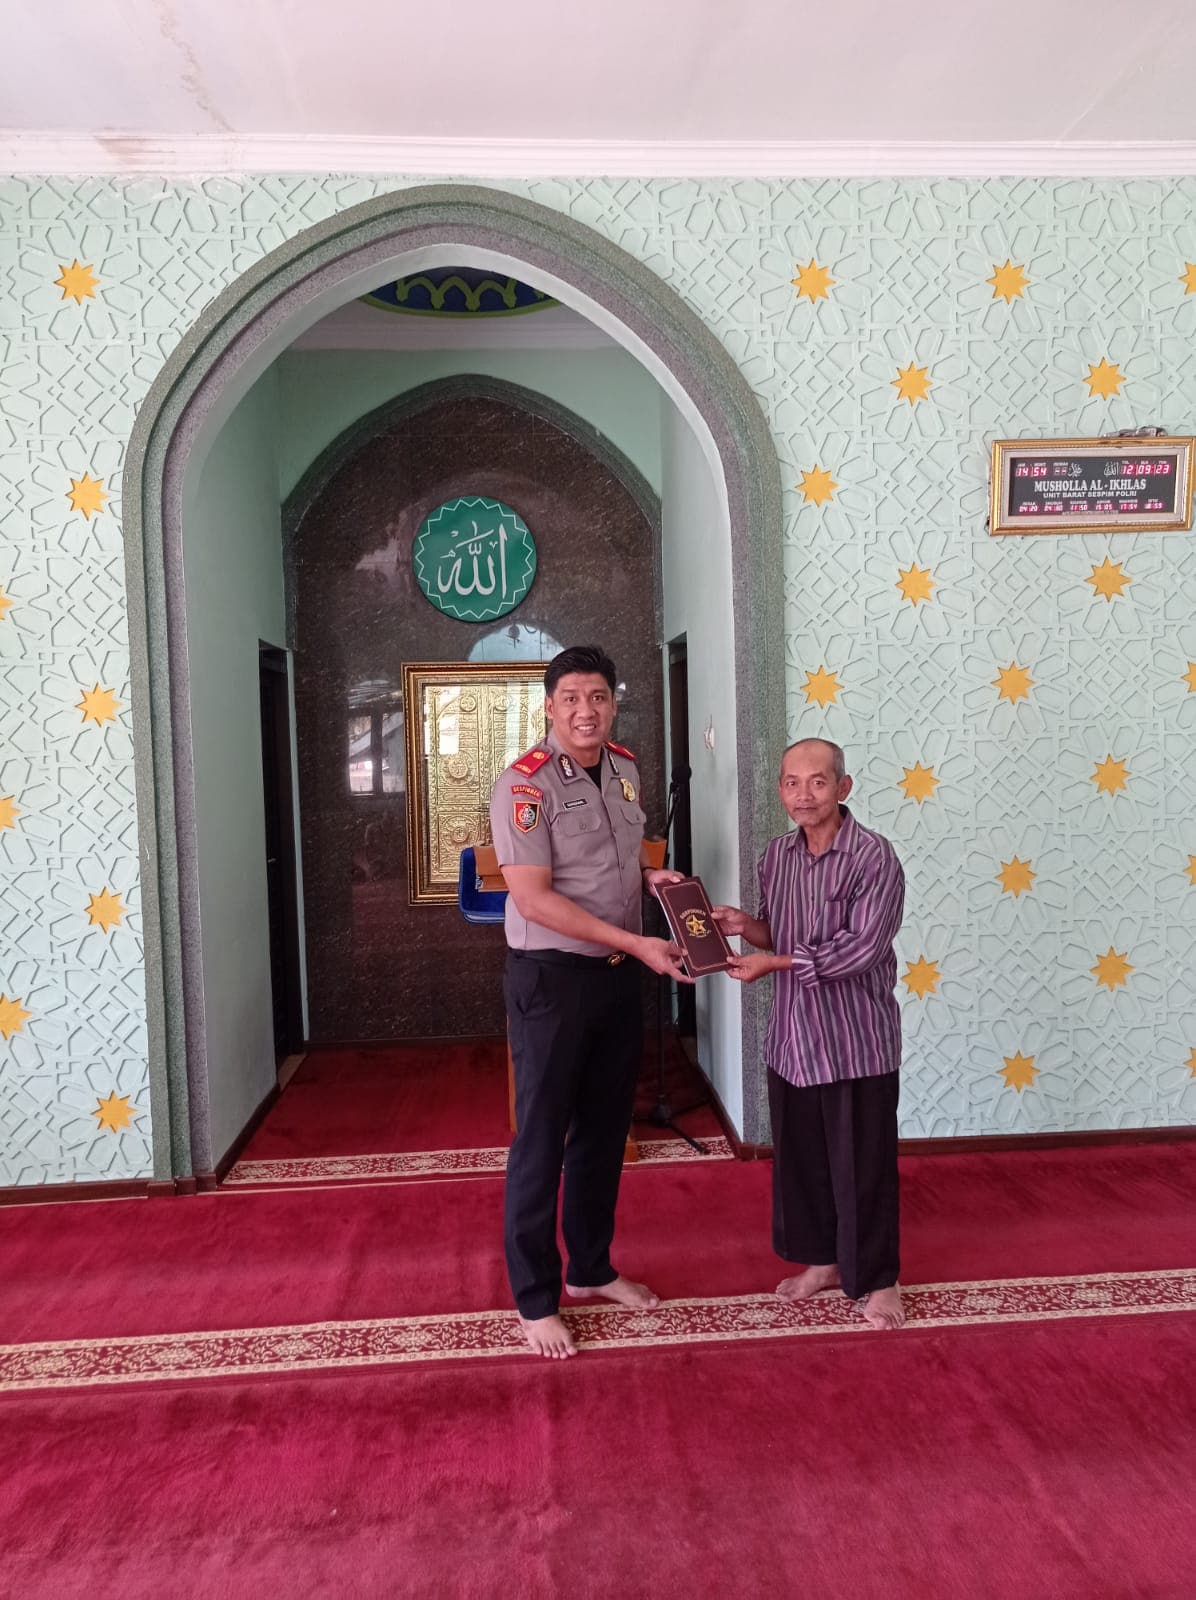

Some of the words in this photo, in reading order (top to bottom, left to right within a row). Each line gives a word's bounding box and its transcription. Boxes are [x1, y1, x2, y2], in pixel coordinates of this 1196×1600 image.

[1034, 479, 1087, 492] MUSHOLLA
[1043, 491, 1061, 499] UNIT
[1088, 490, 1115, 498] SESPIM
